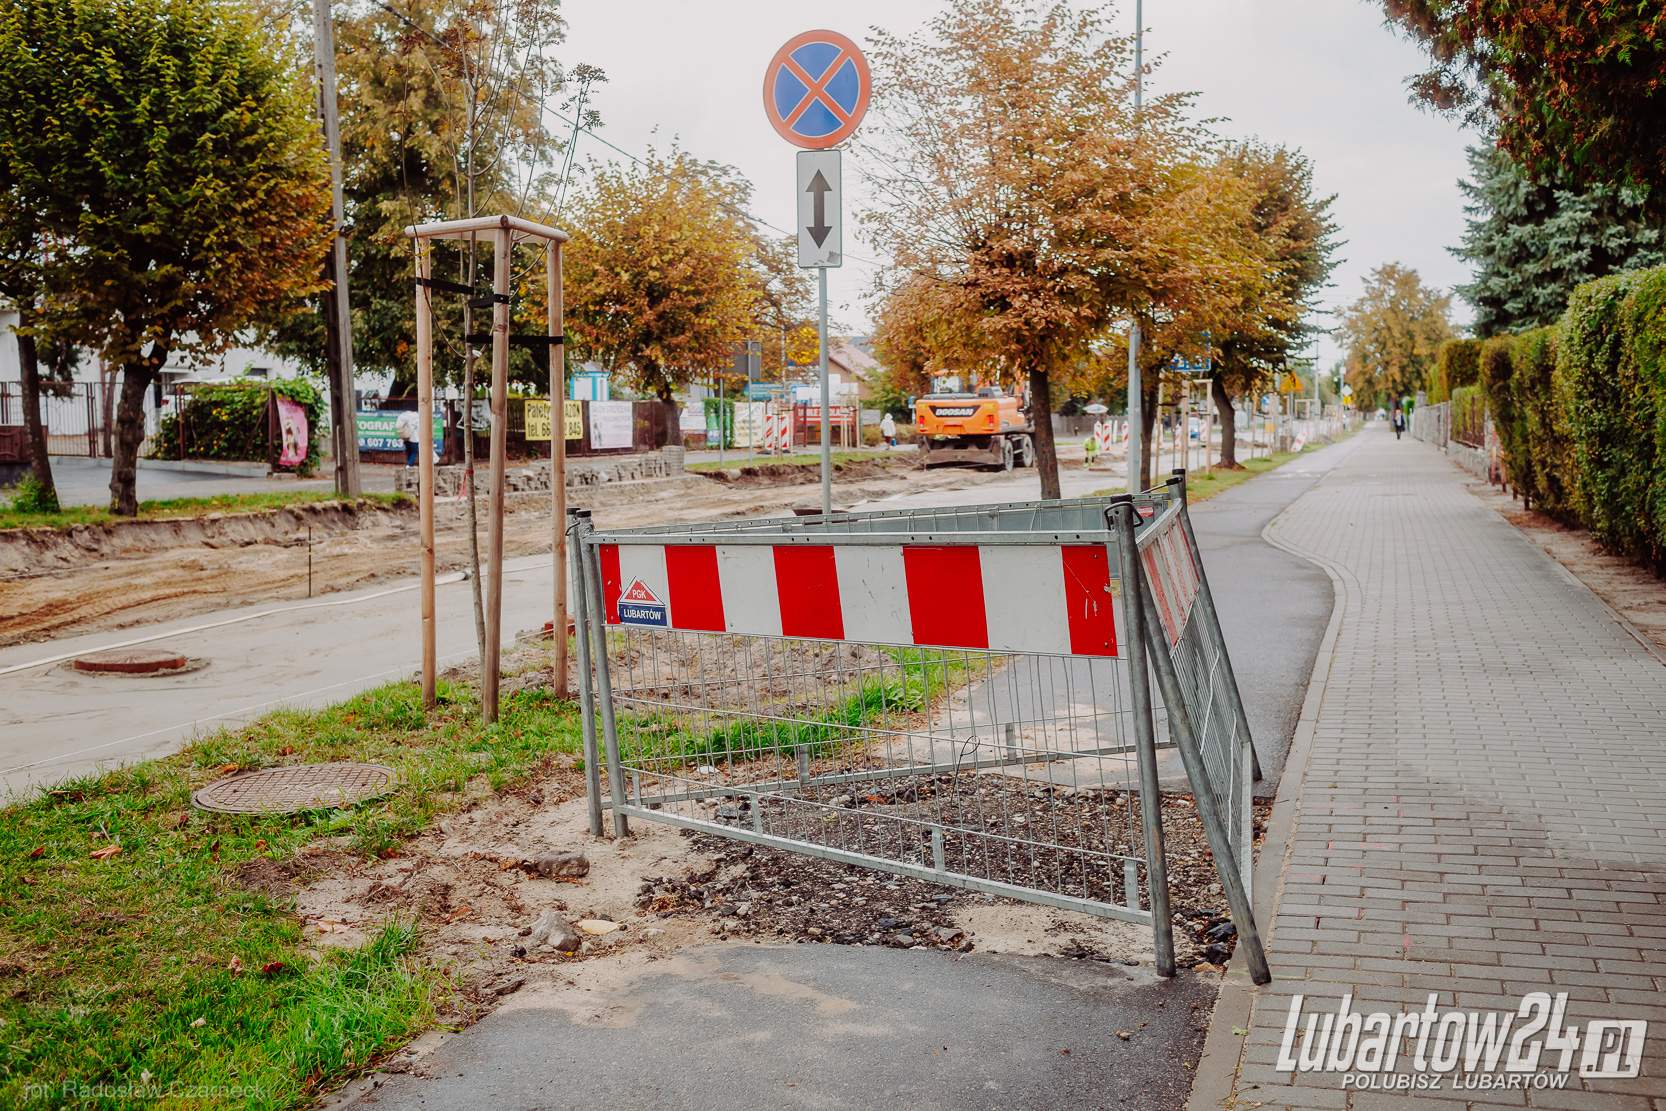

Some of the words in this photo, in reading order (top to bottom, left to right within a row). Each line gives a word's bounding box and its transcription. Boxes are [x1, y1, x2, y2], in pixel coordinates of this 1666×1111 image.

[935, 408, 974, 416] DOOSAN
[632, 589, 647, 599] PGK
[623, 608, 661, 620] LUBARTÓW
